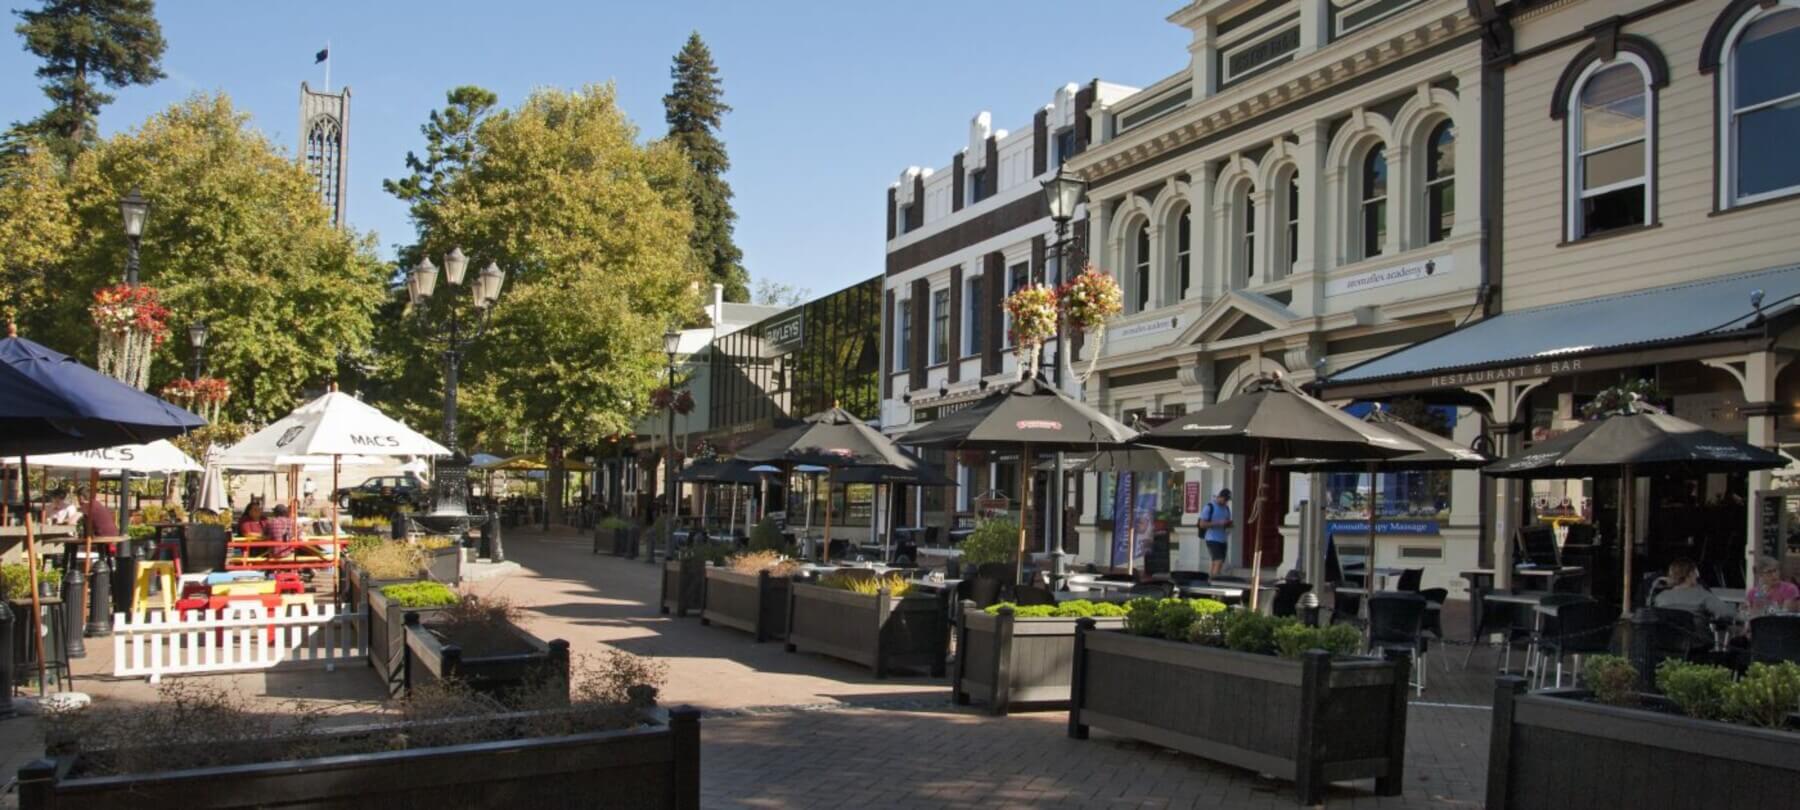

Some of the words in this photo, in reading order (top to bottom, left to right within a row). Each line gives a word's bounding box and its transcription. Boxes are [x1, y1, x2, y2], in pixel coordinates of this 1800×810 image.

[766, 320, 799, 345] BAYLEYS
[1431, 366, 1525, 387] RESTAURANT
[1534, 364, 1544, 375] &
[1551, 359, 1582, 373] BAR
